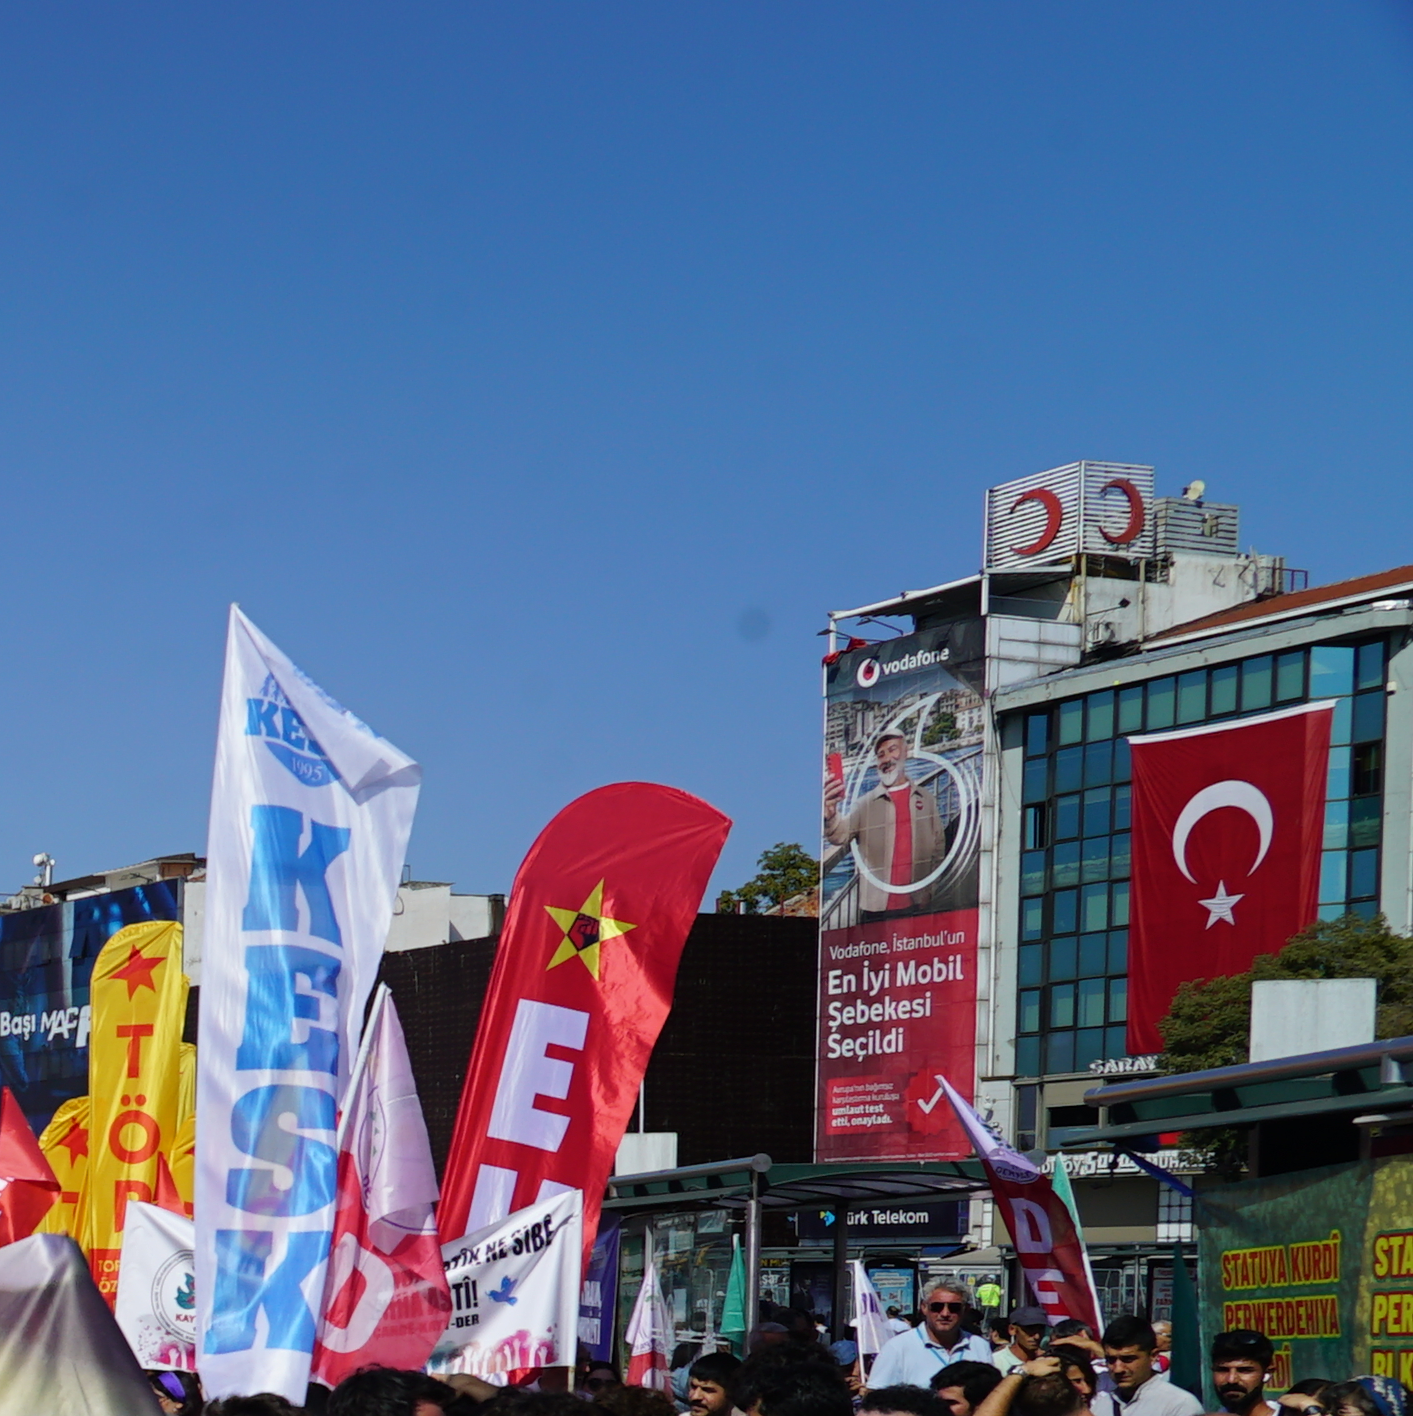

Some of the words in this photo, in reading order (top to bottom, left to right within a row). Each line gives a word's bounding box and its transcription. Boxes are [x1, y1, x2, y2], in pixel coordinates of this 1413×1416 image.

[882, 646, 949, 676] vodafone
[292, 757, 323, 782] 1995
[829, 941, 890, 961] Vodafone,
[892, 930, 965, 953] İstanbul'un
[827, 969, 856, 995] En
[863, 960, 890, 997] İyi
[896, 954, 964, 987] Mobil
[0, 1011, 36, 1041] Başı
[827, 991, 931, 1033] Şebekesi
[827, 1027, 904, 1062] Seçildi
[1089, 1054, 1158, 1074] SARAY
[203, 804, 351, 1355] KESK
[865, 1103, 884, 1113] test
[846, 1211, 869, 1226] ürk
[871, 1209, 929, 1225] Telekom
[1222, 1245, 1288, 1291] STATUYA
[1288, 1229, 1342, 1285] KURDÎ
